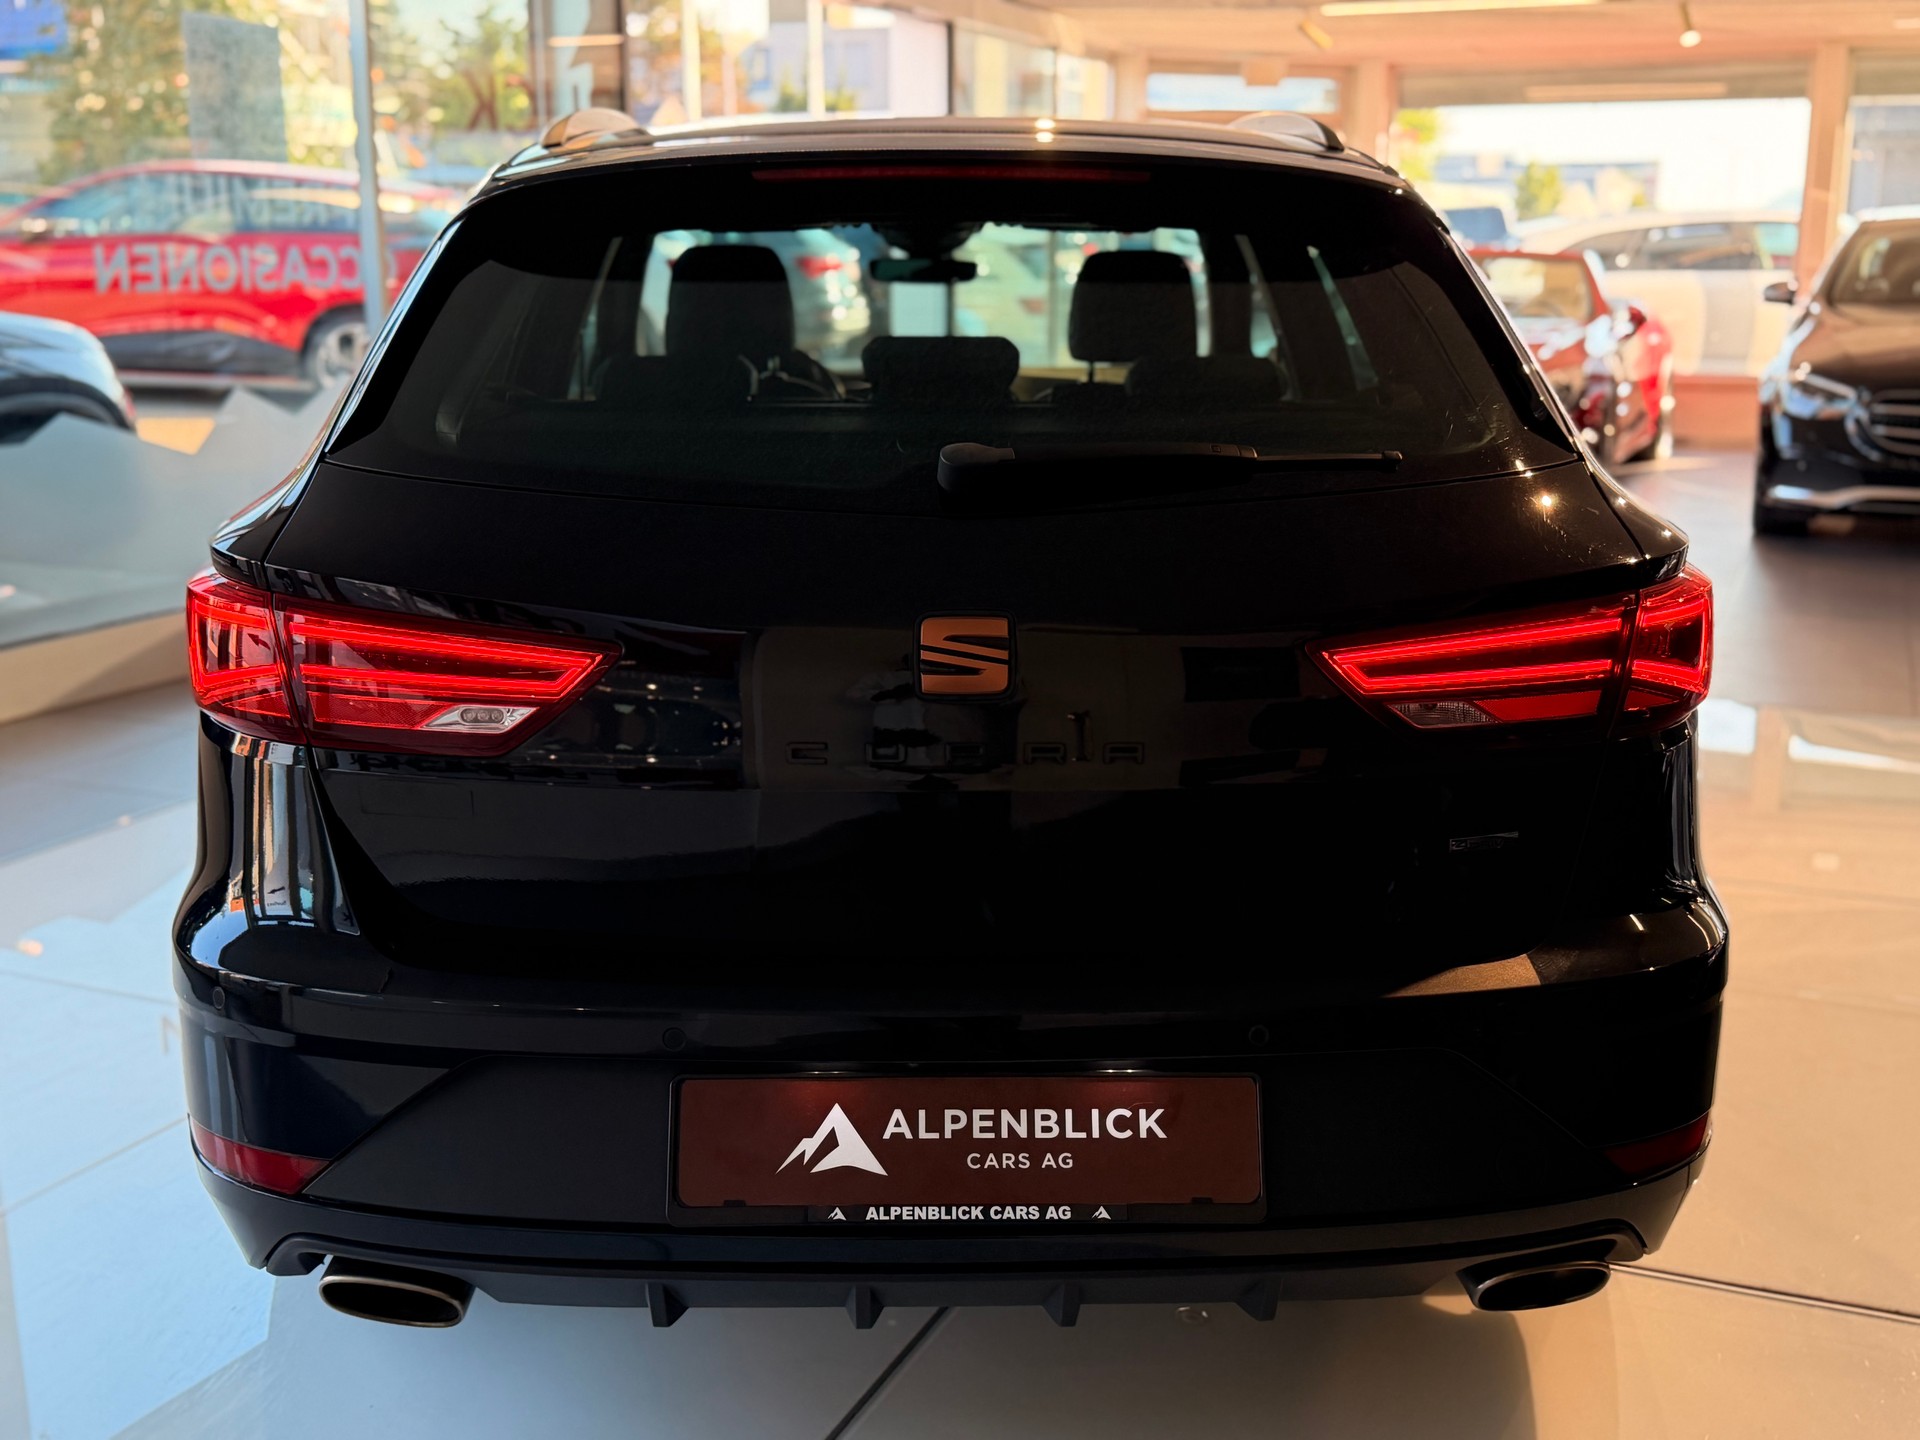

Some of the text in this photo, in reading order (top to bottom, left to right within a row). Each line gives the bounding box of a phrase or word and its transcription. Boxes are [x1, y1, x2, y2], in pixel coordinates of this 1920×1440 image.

[786, 742, 1145, 766] CUPRA
[883, 1108, 1167, 1140] ALPENBLICK
[967, 1152, 1074, 1169] CARS AG
[866, 1205, 1072, 1221] ALPENBLICK CARS AG
